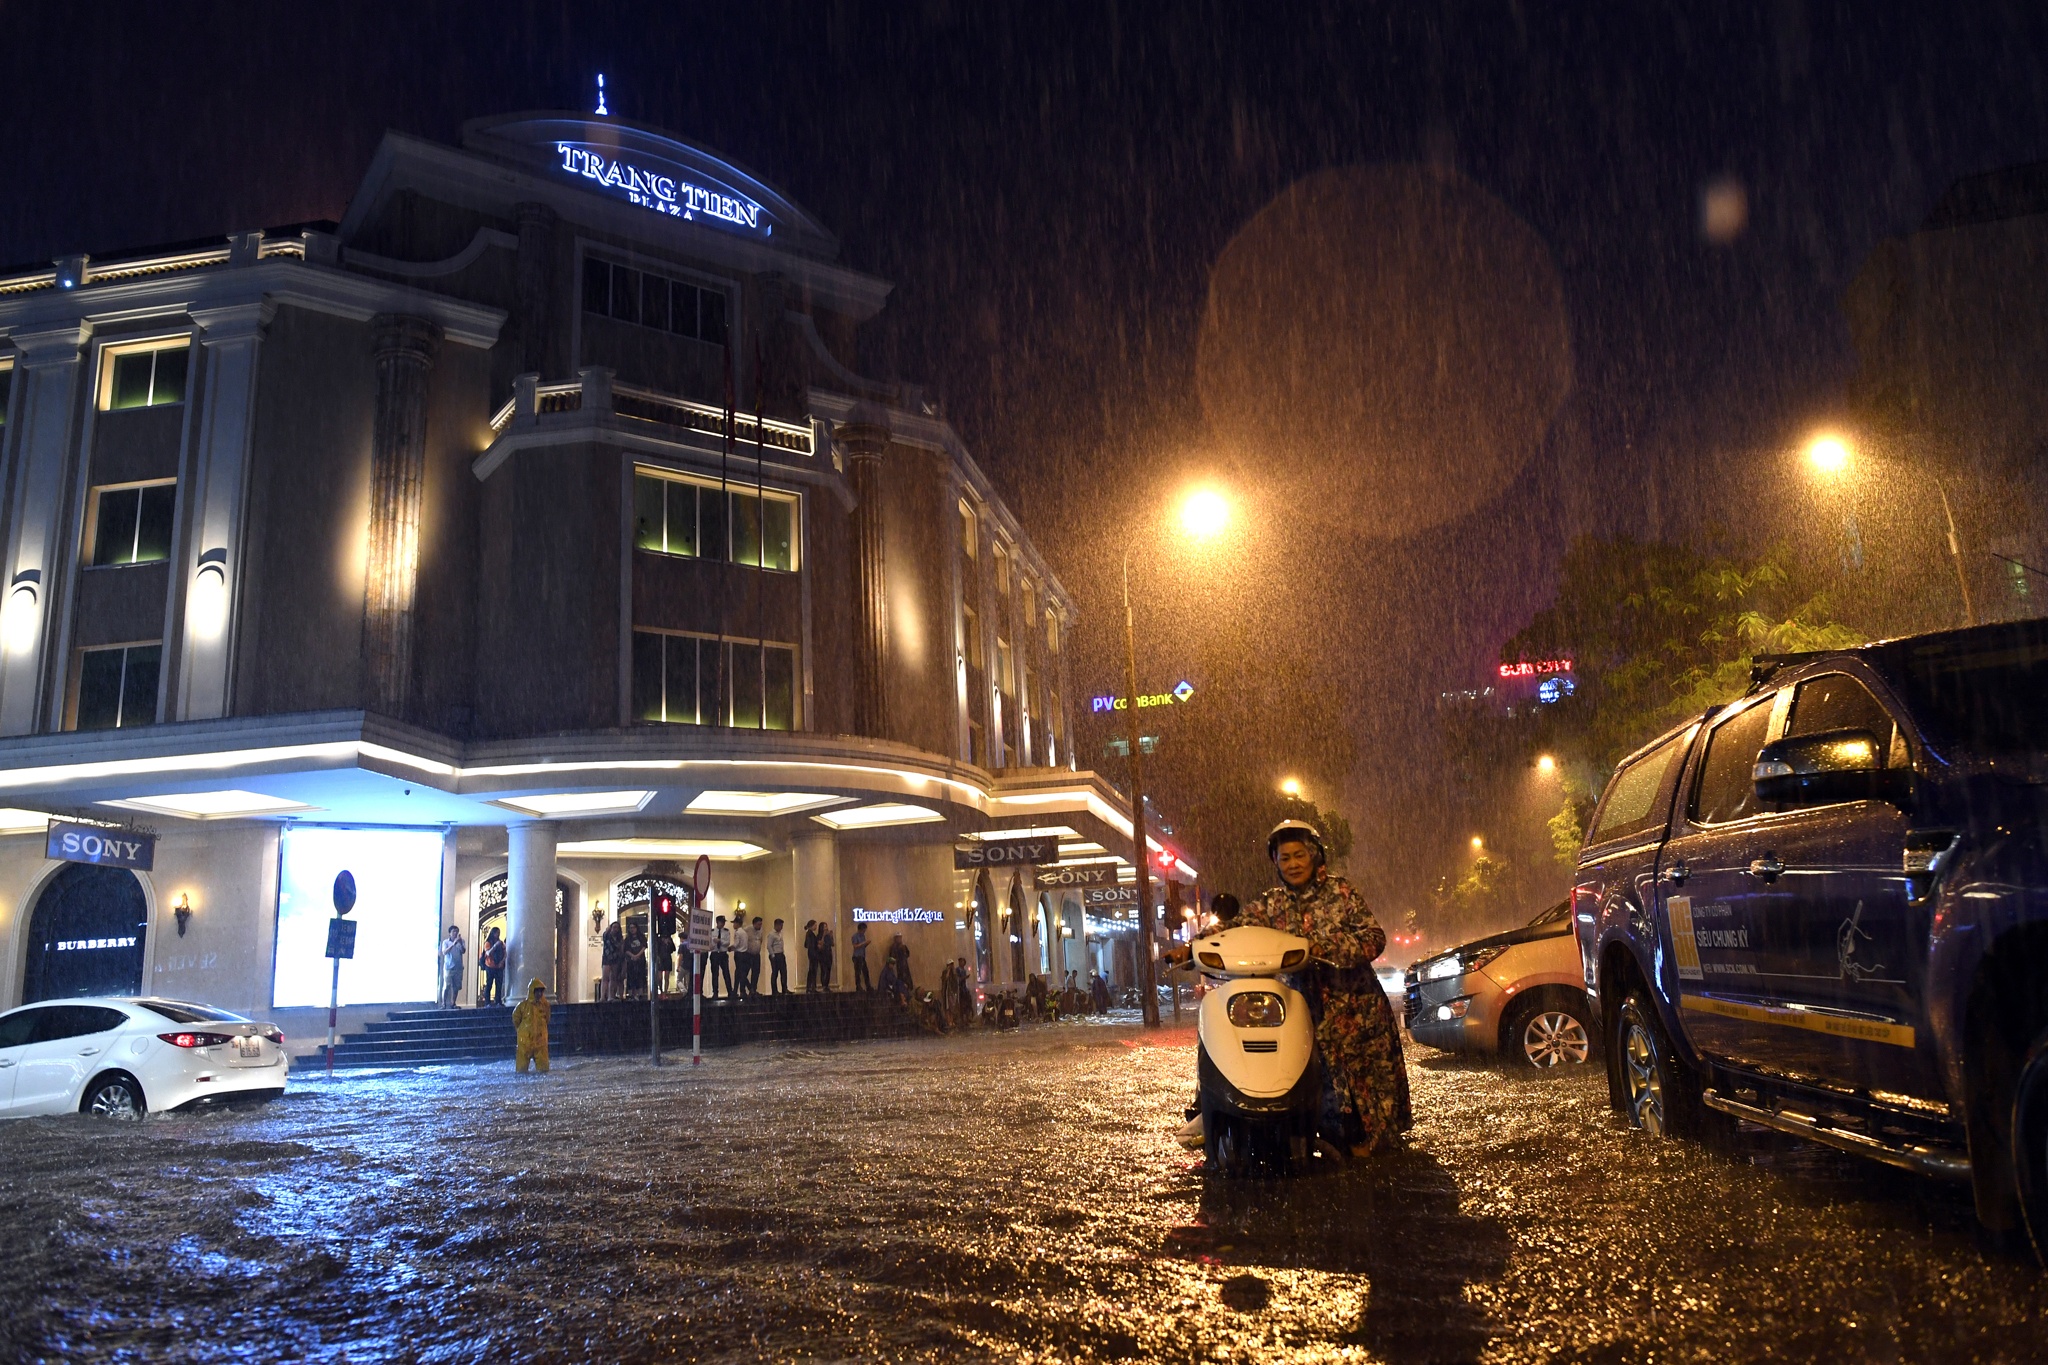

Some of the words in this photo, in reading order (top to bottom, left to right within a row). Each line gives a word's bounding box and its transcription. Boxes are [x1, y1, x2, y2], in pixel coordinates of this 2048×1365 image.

[558, 144, 676, 201] TRANG
[682, 183, 759, 228] TIEN
[628, 192, 693, 220] PLAZA
[1093, 693, 1174, 712] PVcoBank
[62, 832, 141, 860] SONY
[968, 844, 1045, 863] SONY
[1044, 870, 1107, 885] SONY
[1092, 889, 1137, 902] SON
[57, 937, 136, 951] BURBERRY
[1697, 926, 1712, 947] SIÊU
[1712, 930, 1737, 947] CHUNG
[1737, 925, 1748, 947] KỲ
